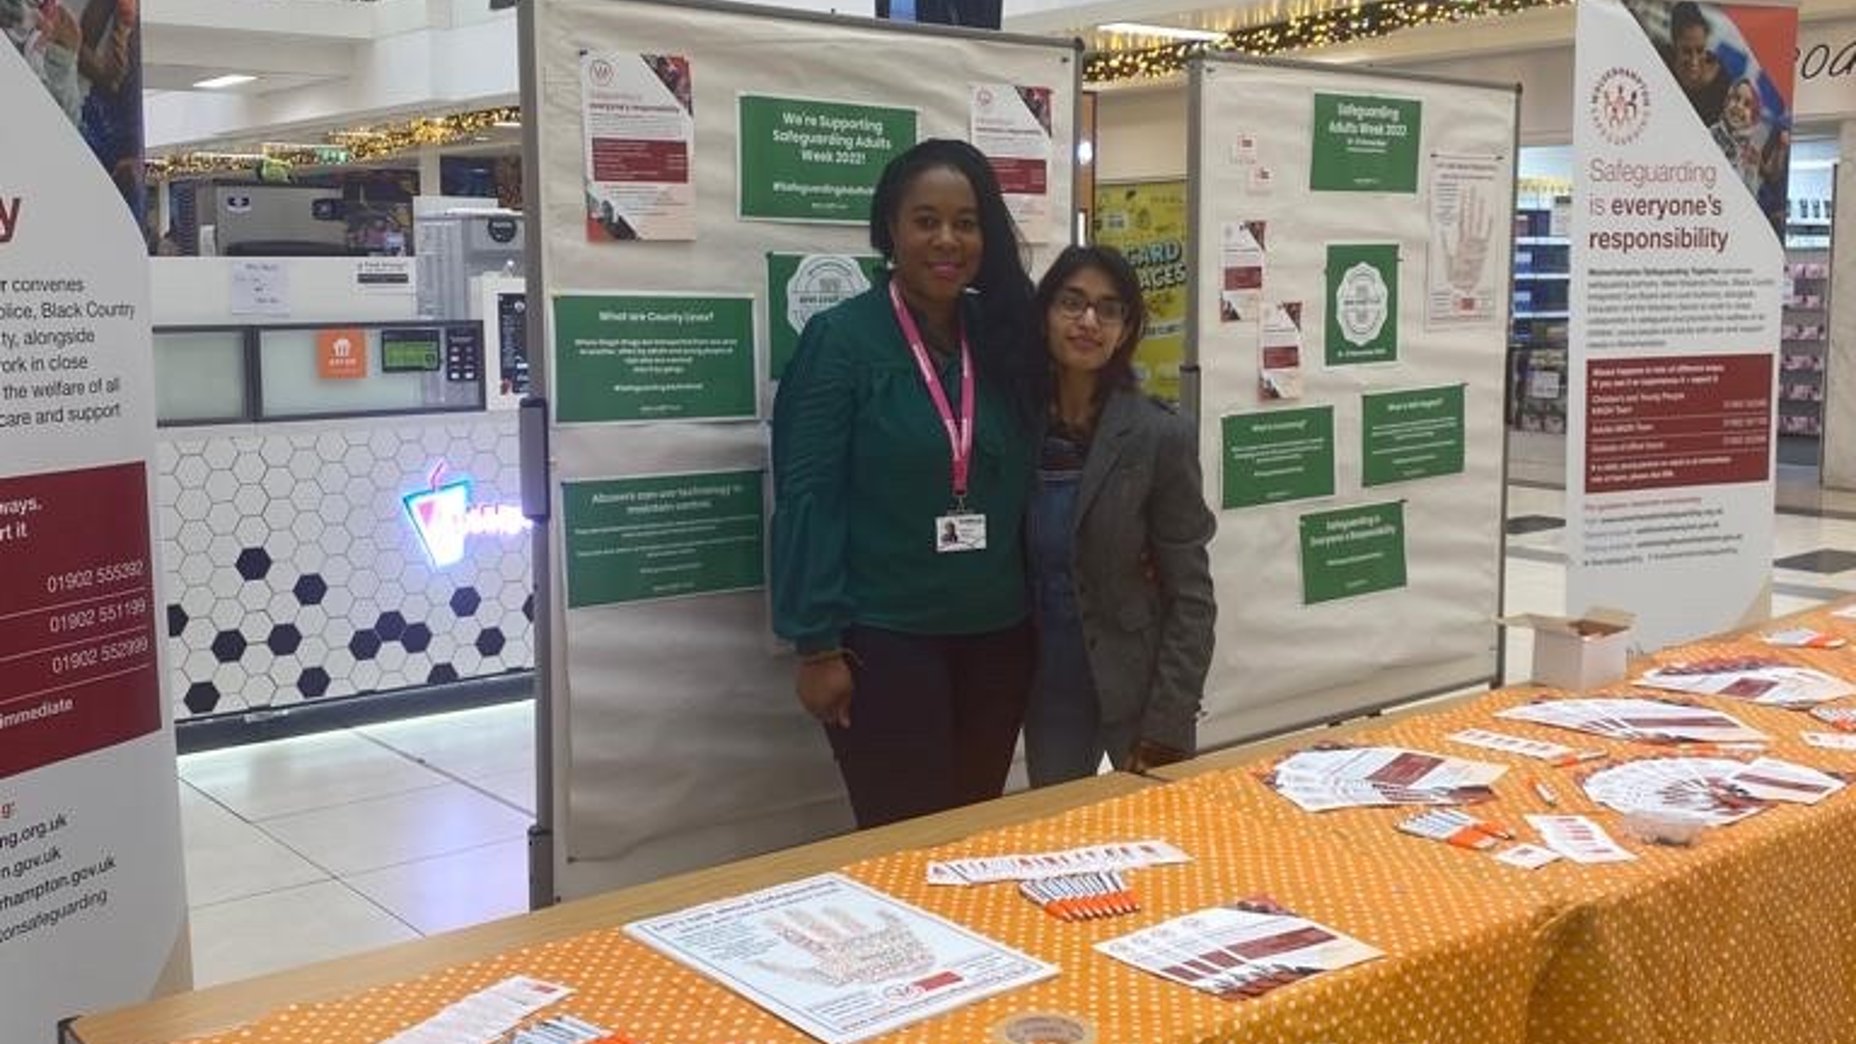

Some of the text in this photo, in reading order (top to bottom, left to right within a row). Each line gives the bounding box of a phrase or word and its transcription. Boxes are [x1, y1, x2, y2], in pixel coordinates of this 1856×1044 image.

[783, 111, 883, 135] We're Supporting
[1337, 102, 1400, 123] Safeguarding
[1328, 121, 1357, 134] Adults
[773, 129, 892, 151] Safeguarding Adults
[801, 150, 833, 163] Week
[1589, 158, 1717, 189] Safeguarding
[1589, 193, 1722, 220] is everyone's
[1589, 226, 1729, 254] responsibility
[12, 279, 84, 293] convenes
[41, 302, 82, 319] Black
[86, 300, 135, 320] Country
[24, 327, 95, 350] alongside
[0, 353, 88, 374] ork in close
[3, 377, 119, 400] the welfare of all
[38, 407, 64, 425] and
[67, 402, 121, 424] support
[17, 522, 28, 539] it
[47, 569, 93, 594] 01902
[50, 608, 95, 633] 01902
[52, 649, 98, 674] 01902
[0, 697, 73, 729] immediate
[0, 813, 67, 849] ng.org.uk
